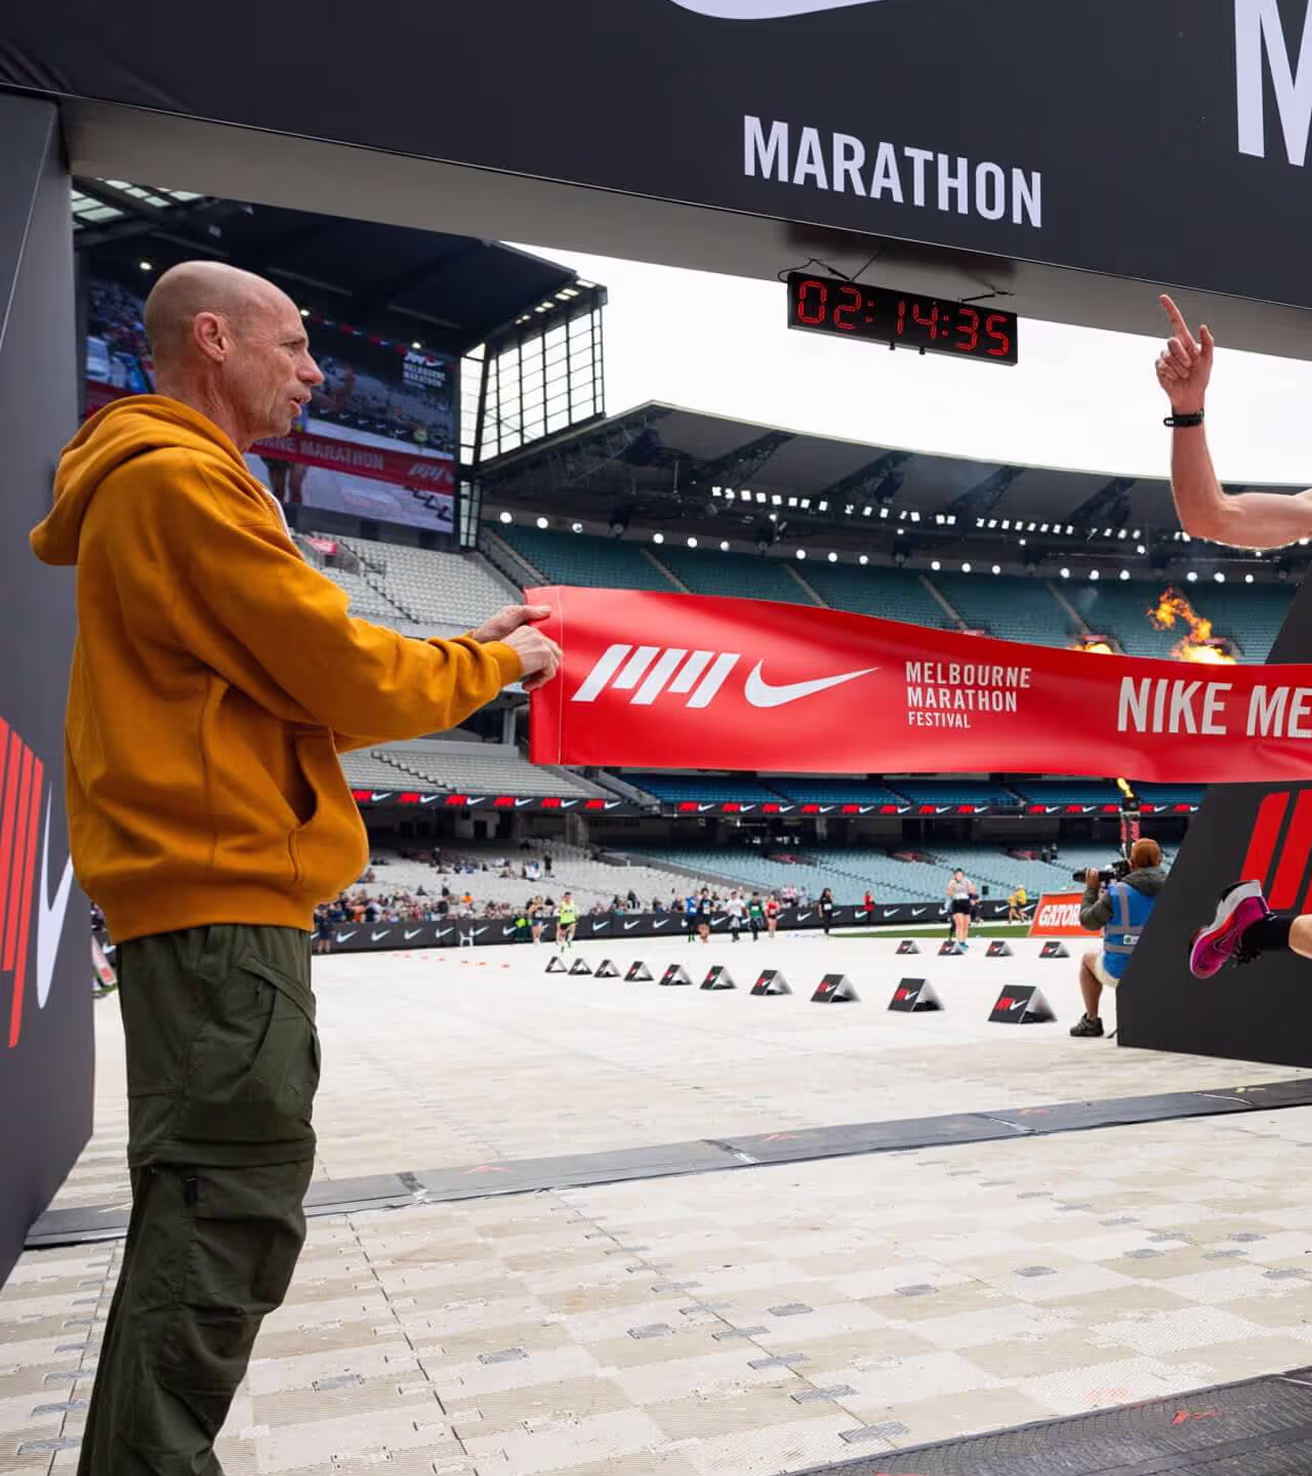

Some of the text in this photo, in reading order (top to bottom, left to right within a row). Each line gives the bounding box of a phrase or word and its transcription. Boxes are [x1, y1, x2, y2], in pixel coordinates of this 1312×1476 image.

[744, 115, 1042, 228] MARATHON
[797, 281, 1010, 357] 02:14:35
[905, 661, 1032, 689] MELBOURNE
[906, 686, 1017, 712] MARATHON
[908, 711, 971, 729] FESTIVAL
[1118, 677, 1232, 734] NIKE
